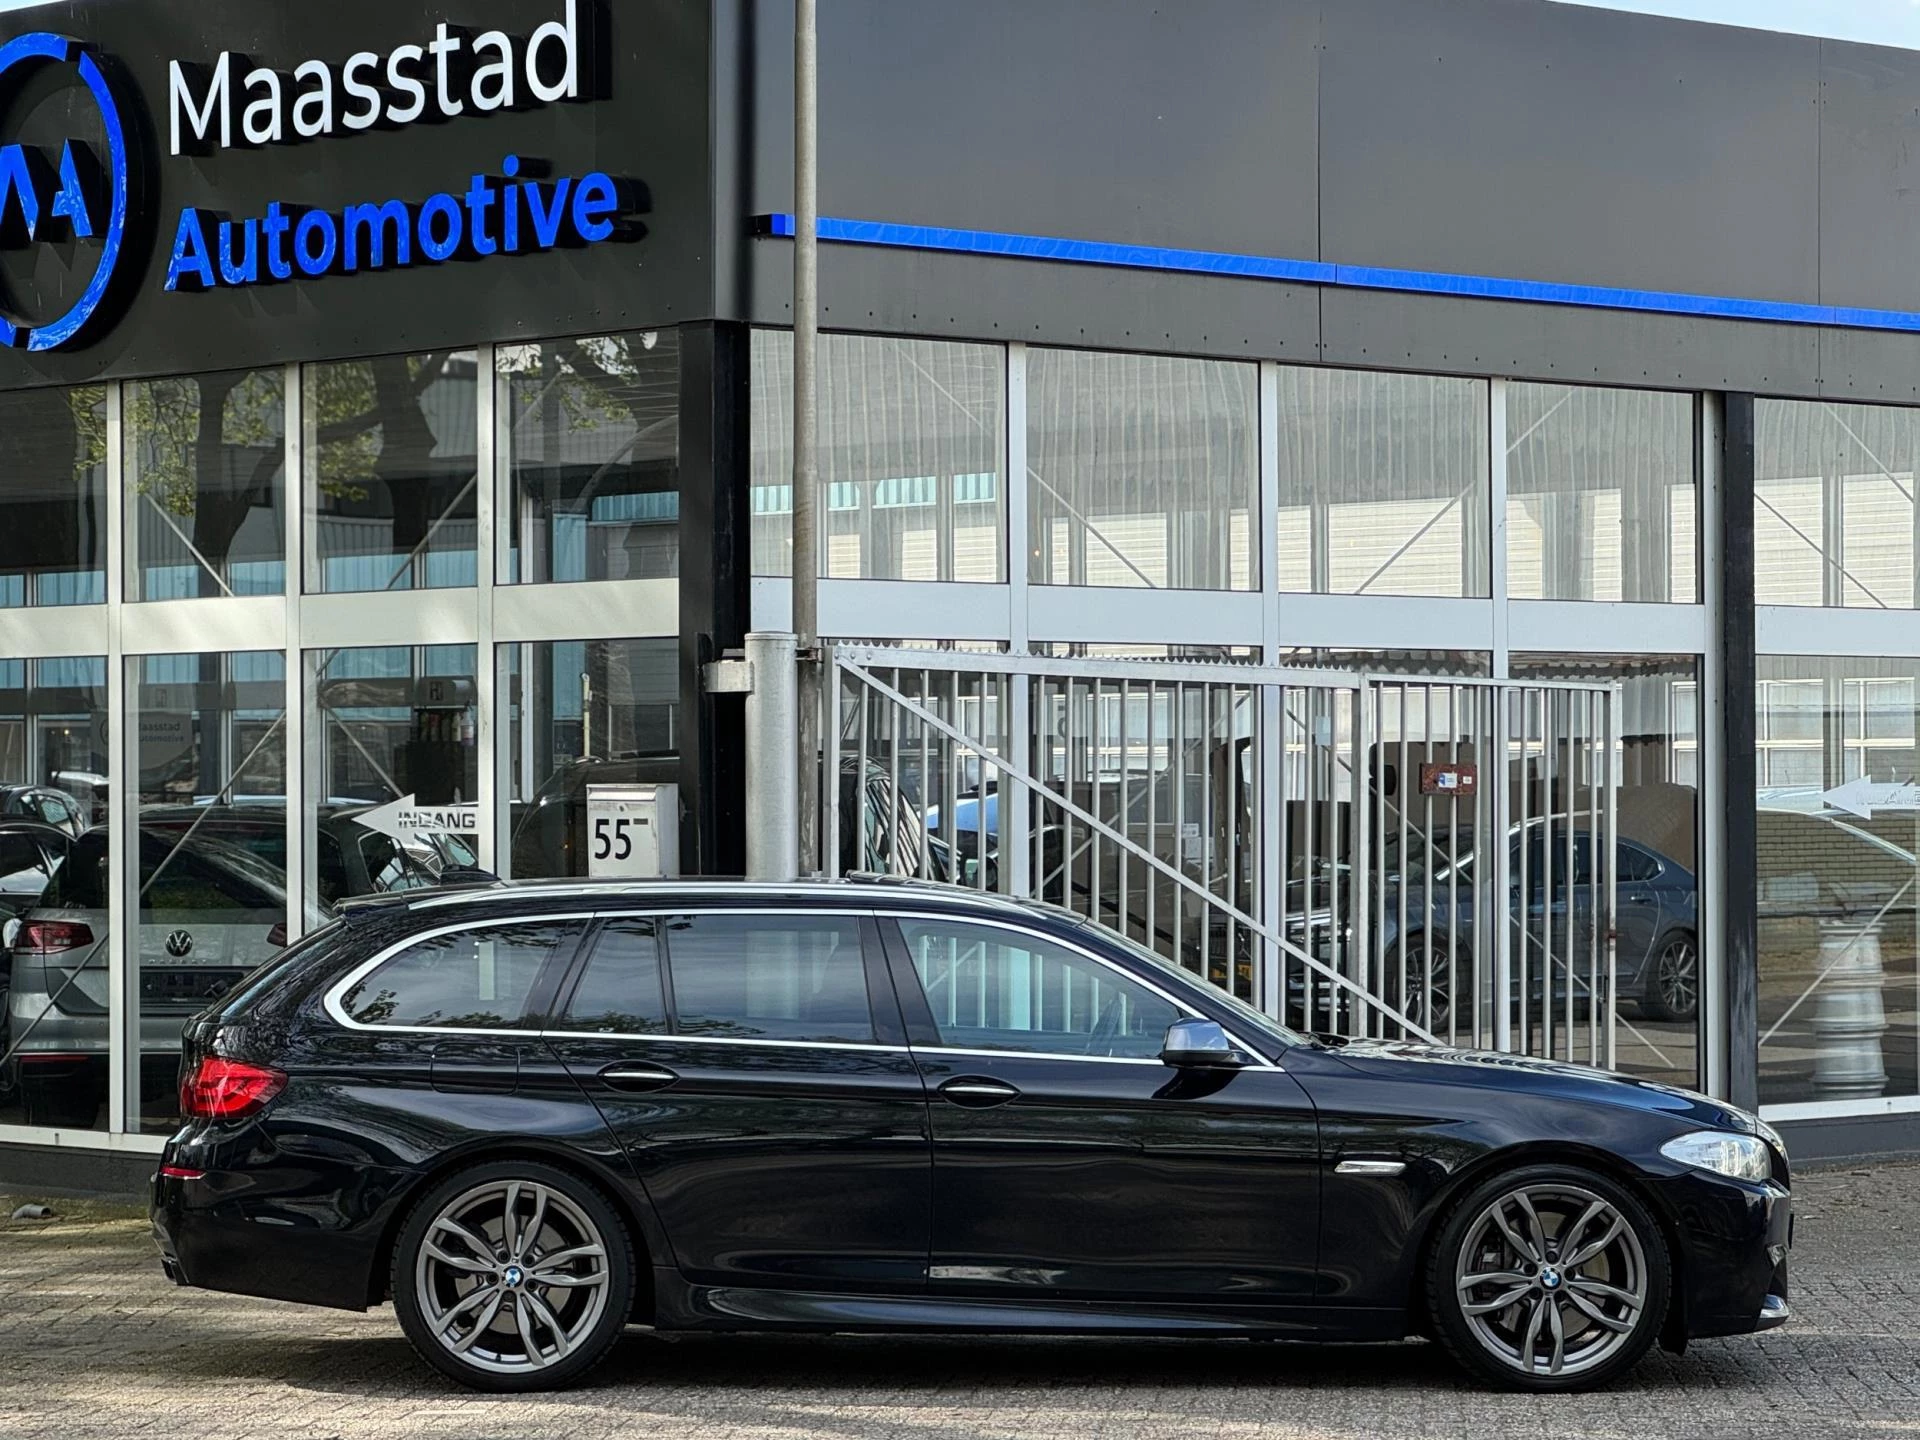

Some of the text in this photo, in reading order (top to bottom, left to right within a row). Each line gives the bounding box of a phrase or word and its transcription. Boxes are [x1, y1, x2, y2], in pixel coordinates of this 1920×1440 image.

[169, 0, 578, 156] Maasstad
[164, 154, 619, 291] Automotive
[594, 818, 632, 860] 55
